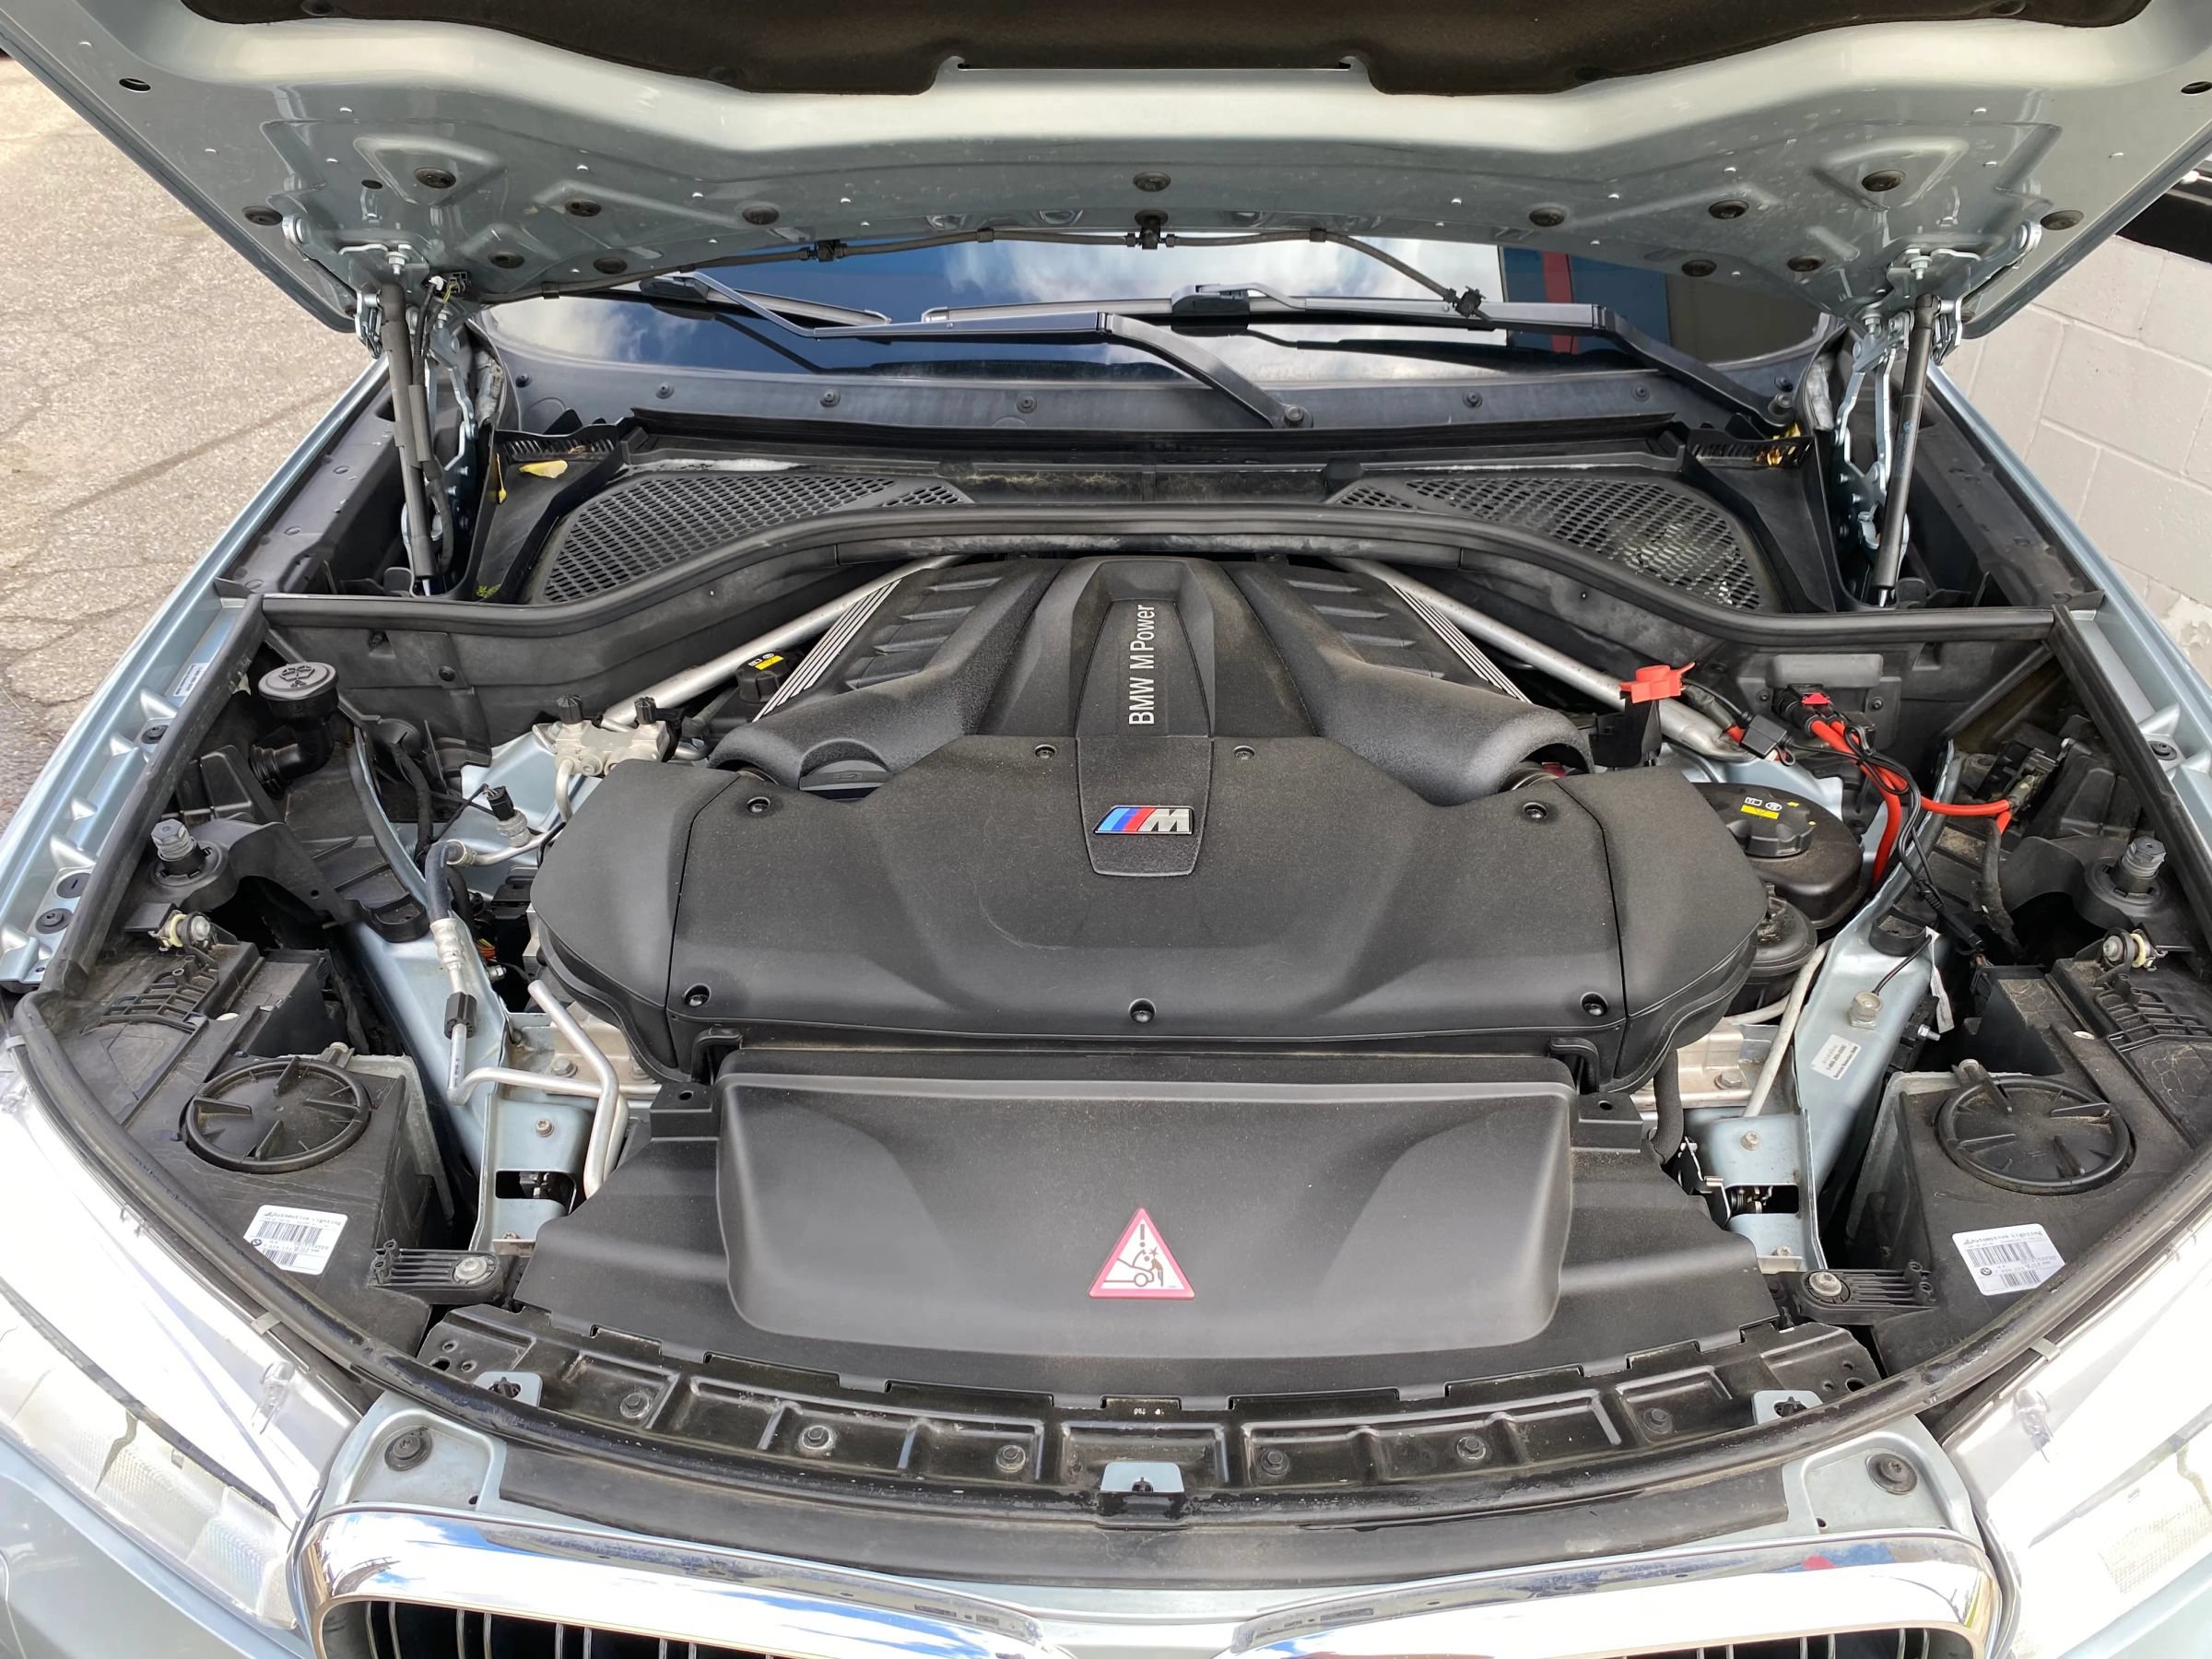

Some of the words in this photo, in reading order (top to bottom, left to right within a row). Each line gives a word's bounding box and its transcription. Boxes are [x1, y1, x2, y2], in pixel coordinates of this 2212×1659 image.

[1130, 605, 1155, 651] Power
[1129, 654, 1155, 669] M
[1128, 677, 1155, 724] BMW
[1138, 808, 1190, 832] M
